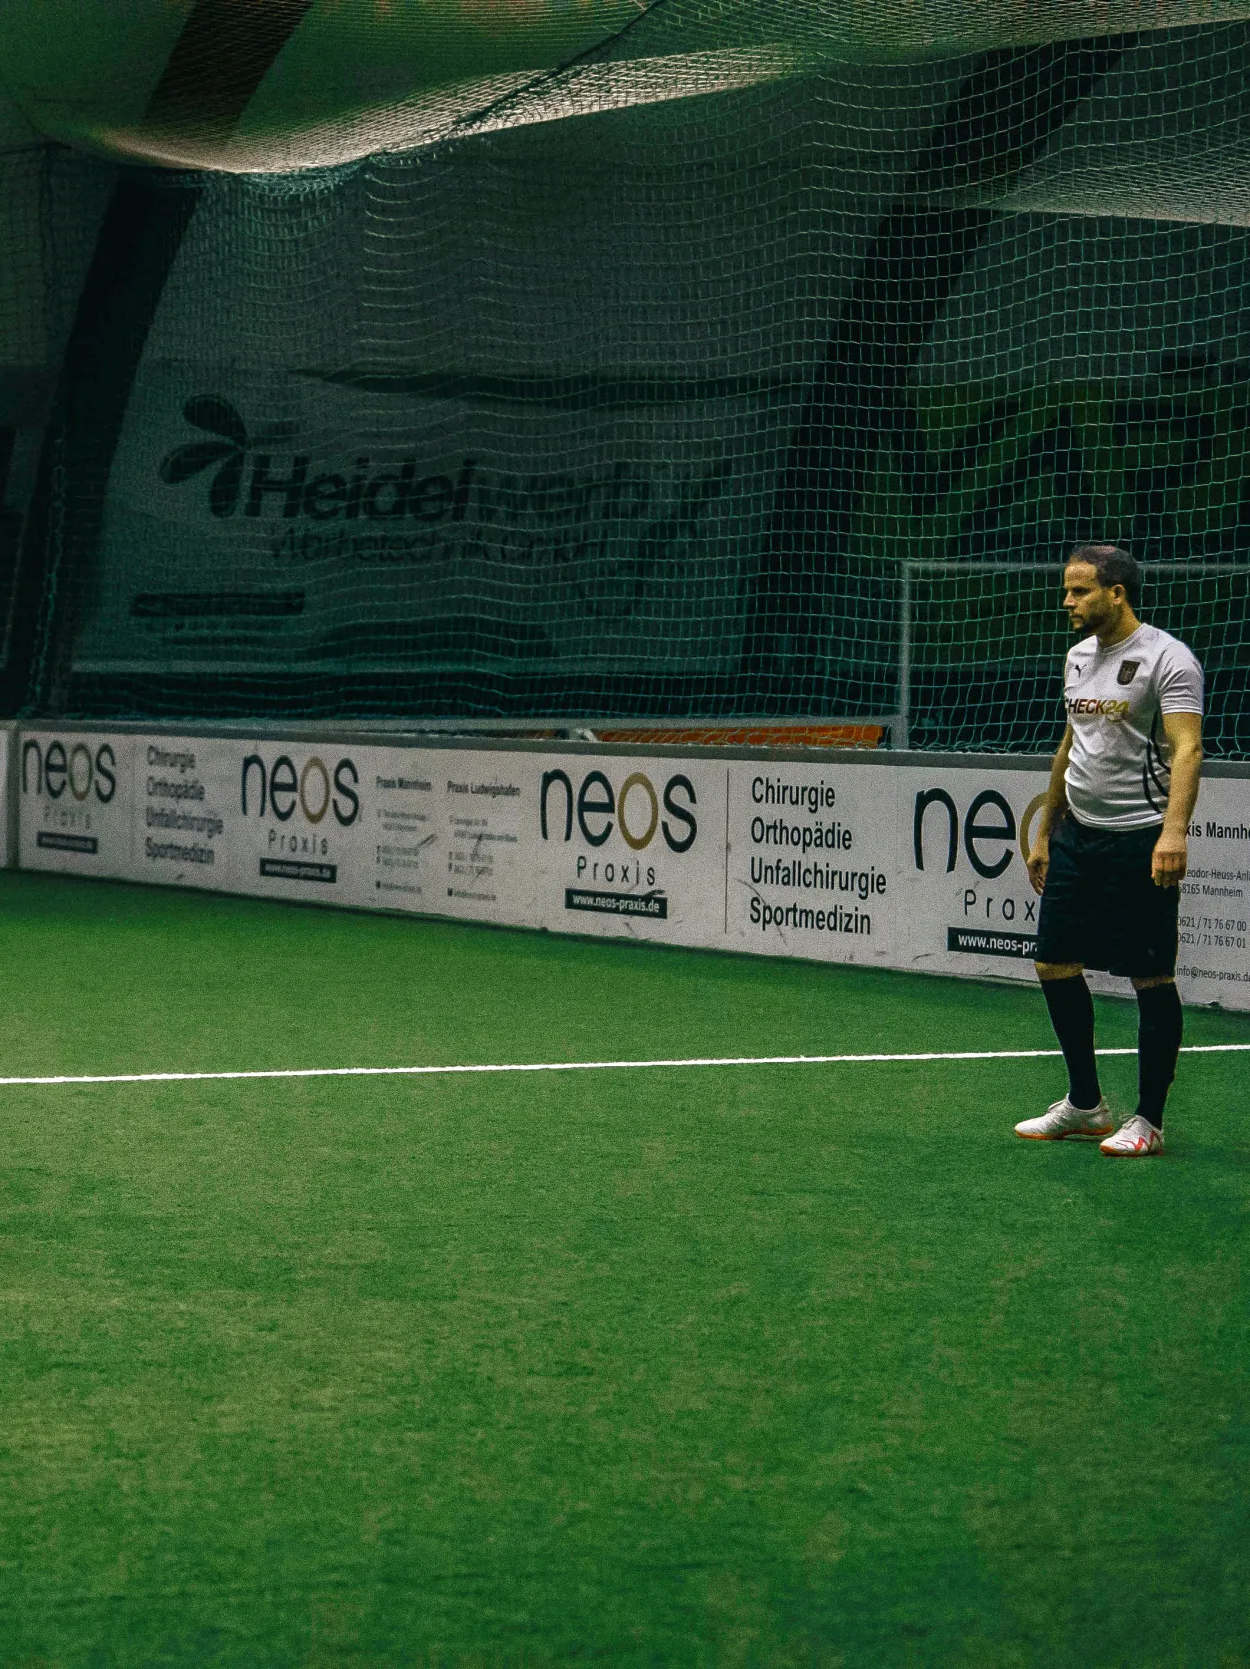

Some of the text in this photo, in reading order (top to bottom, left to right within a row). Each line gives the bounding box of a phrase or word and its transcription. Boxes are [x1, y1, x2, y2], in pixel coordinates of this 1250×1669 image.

[22, 739, 117, 803] neos
[147, 745, 196, 773] Chirurgie
[242, 754, 359, 827] neos
[751, 776, 836, 814] Chirurgie
[540, 768, 698, 853] neos
[269, 830, 329, 856] Praxis
[751, 817, 852, 851] Orthopädie
[1206, 822, 1250, 840] Mannh
[577, 855, 656, 886] Praxis
[750, 855, 886, 900] Unfallchirurgie
[1187, 868, 1250, 882] eodor-Heuss-Anl
[572, 893, 660, 914] www.neos-praxis.de
[964, 889, 1036, 921] Prax
[1203, 884, 1244, 898] Mannheim
[749, 897, 872, 936] Sportmedizin
[1203, 917, 1212, 929] 71
[1214, 918, 1224, 930] 76
[1225, 919, 1236, 931] 67
[1203, 934, 1212, 946] 71
[1214, 935, 1224, 947] 76
[1225, 936, 1236, 948] 67
